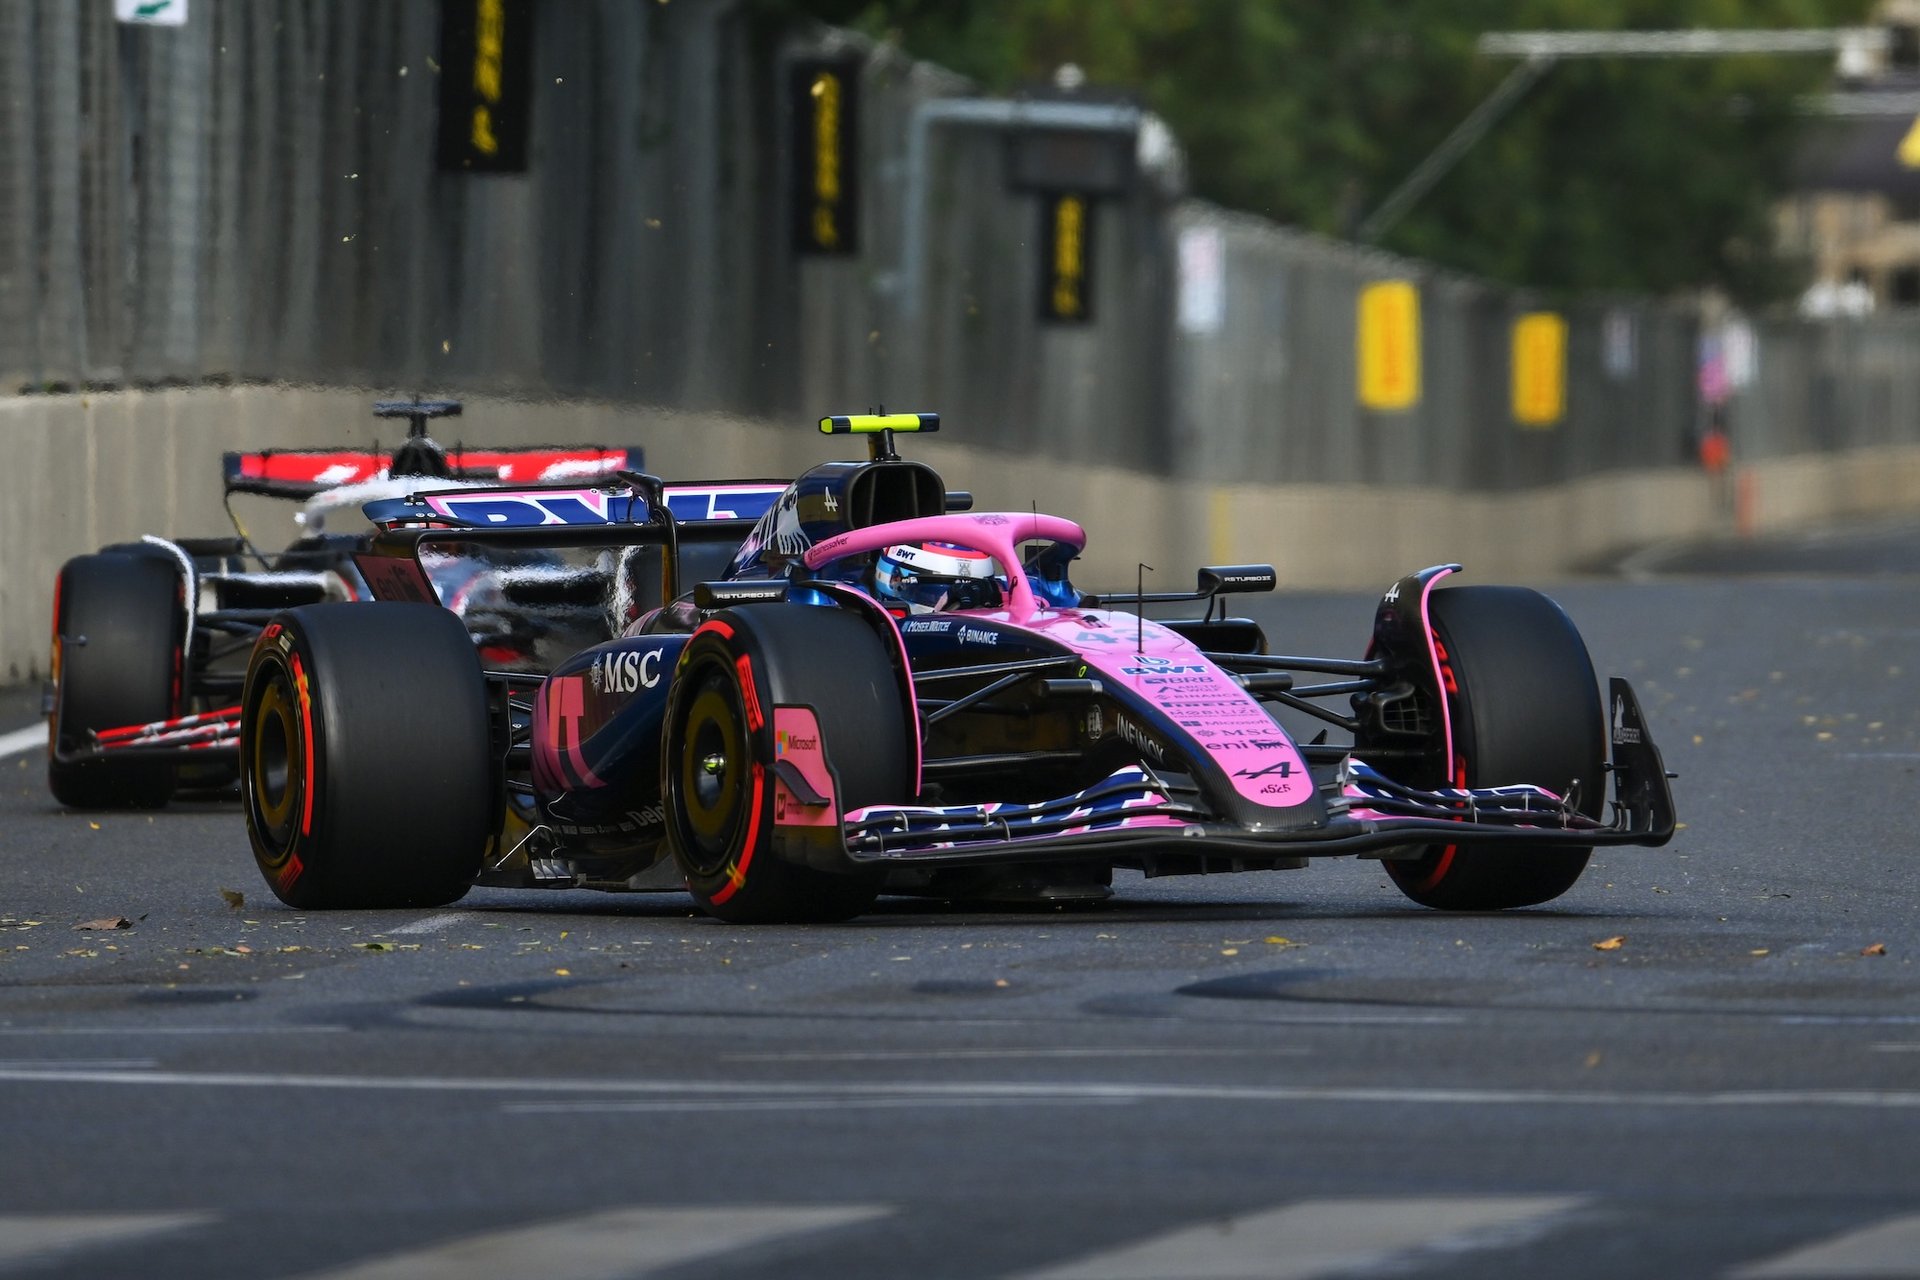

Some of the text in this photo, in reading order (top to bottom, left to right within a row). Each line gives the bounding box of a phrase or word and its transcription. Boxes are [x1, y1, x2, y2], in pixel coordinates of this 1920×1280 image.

[896, 548, 916, 561] BWT
[966, 629, 999, 645] BINANCE
[1075, 628, 1161, 645] 43
[604, 647, 664, 694] MSC
[1121, 664, 1207, 676] BWT
[1167, 676, 1214, 684] BRB
[1205, 718, 1269, 726] Microsoft
[1221, 728, 1281, 737] MSC
[788, 735, 817, 751] Microsoft
[1205, 740, 1250, 750] eni
